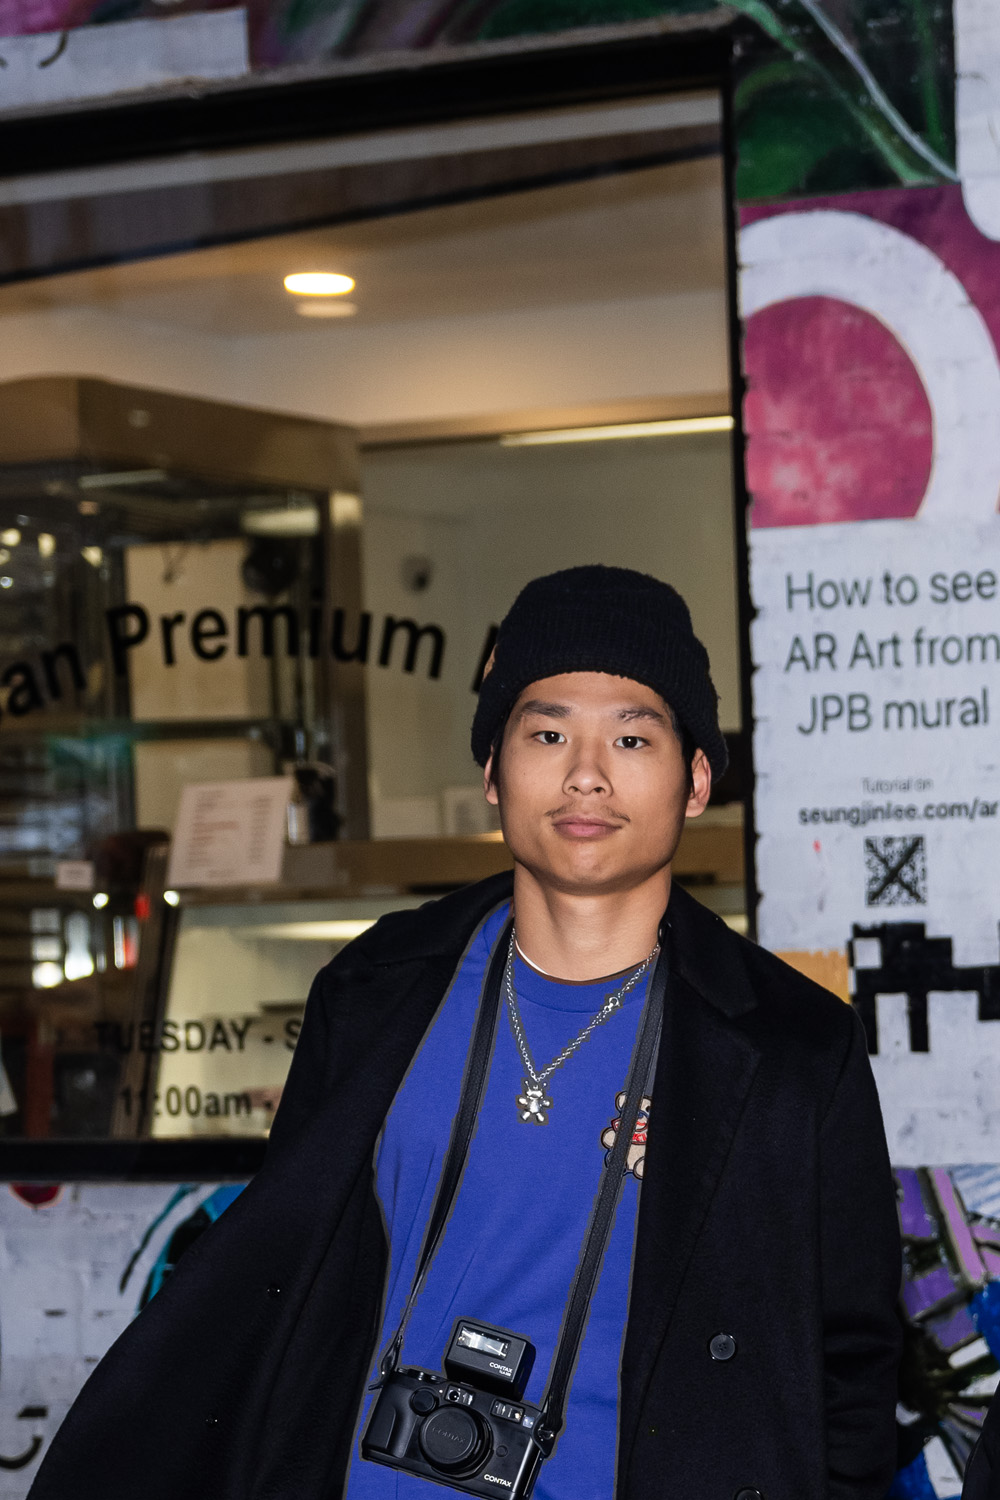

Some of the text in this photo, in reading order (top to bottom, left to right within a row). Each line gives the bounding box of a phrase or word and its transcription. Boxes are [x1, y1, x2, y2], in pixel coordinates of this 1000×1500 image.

[785, 569, 999, 612] How to see
[106, 596, 446, 681] Premium
[785, 632, 838, 672] AR
[849, 631, 905, 671] Art
[797, 687, 989, 736] JPB mural
[861, 777, 934, 794] Tutorial on
[799, 798, 998, 827] seungjinlee.com/ar
[94, 1018, 254, 1053] TUESDAY
[120, 1085, 252, 1117] 11:00am
[489, 1362, 513, 1373] CONTAX
[484, 1473, 512, 1488] CONTAX
